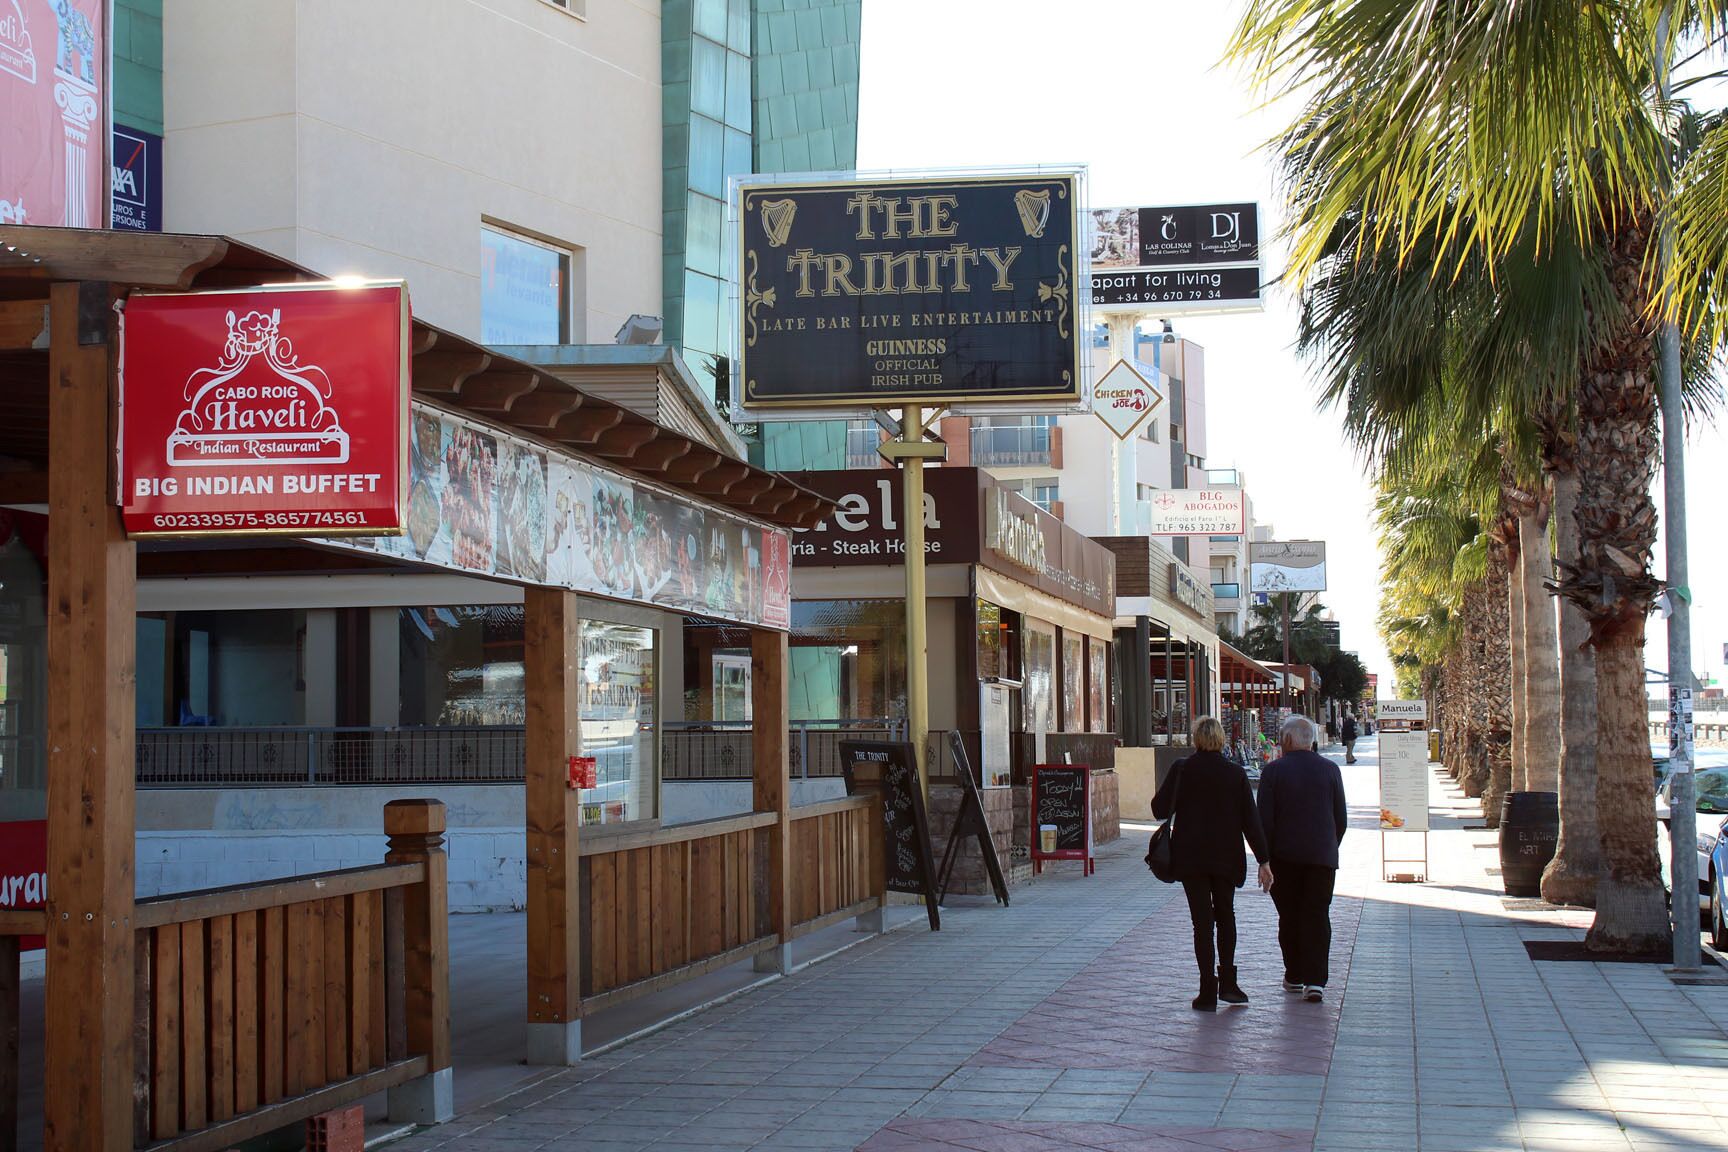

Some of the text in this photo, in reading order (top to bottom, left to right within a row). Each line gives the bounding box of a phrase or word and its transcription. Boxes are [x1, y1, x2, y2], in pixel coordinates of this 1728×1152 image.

[141, 210, 147, 220] E
[847, 191, 959, 240] THE
[1145, 242, 1193, 251] LAS COLINAS
[787, 243, 1022, 298] TRINITY
[1091, 272, 1222, 291] apart for living
[1117, 293, 1139, 302] +34
[1144, 292, 1157, 301] 96
[1163, 291, 1183, 300] 670
[1189, 290, 1202, 299] 79
[1208, 289, 1221, 299] 34
[763, 310, 1055, 332] LATE BAR LIVE ENTERTAIMENT
[866, 338, 947, 356] GUINNESS
[875, 358, 940, 373] OFFICIAL
[871, 373, 943, 386] IRISH PUB
[215, 385, 299, 401] CABO ROIG
[205, 399, 307, 431] Haveli
[194, 438, 321, 459] Indian Restaurant
[135, 472, 381, 497] BIG INDIAN BUFFET
[1200, 491, 1223, 501] BLG
[791, 479, 941, 533] ela
[1183, 503, 1239, 511] ABOGADOS
[153, 510, 368, 528] 602339575-865774561
[1156, 523, 1237, 532] TLF: 965 322 787
[833, 539, 881, 555] Steak
[885, 538, 942, 554] Hose
[1382, 704, 1422, 713] Manuela
[854, 751, 889, 762] THE TRINITY
